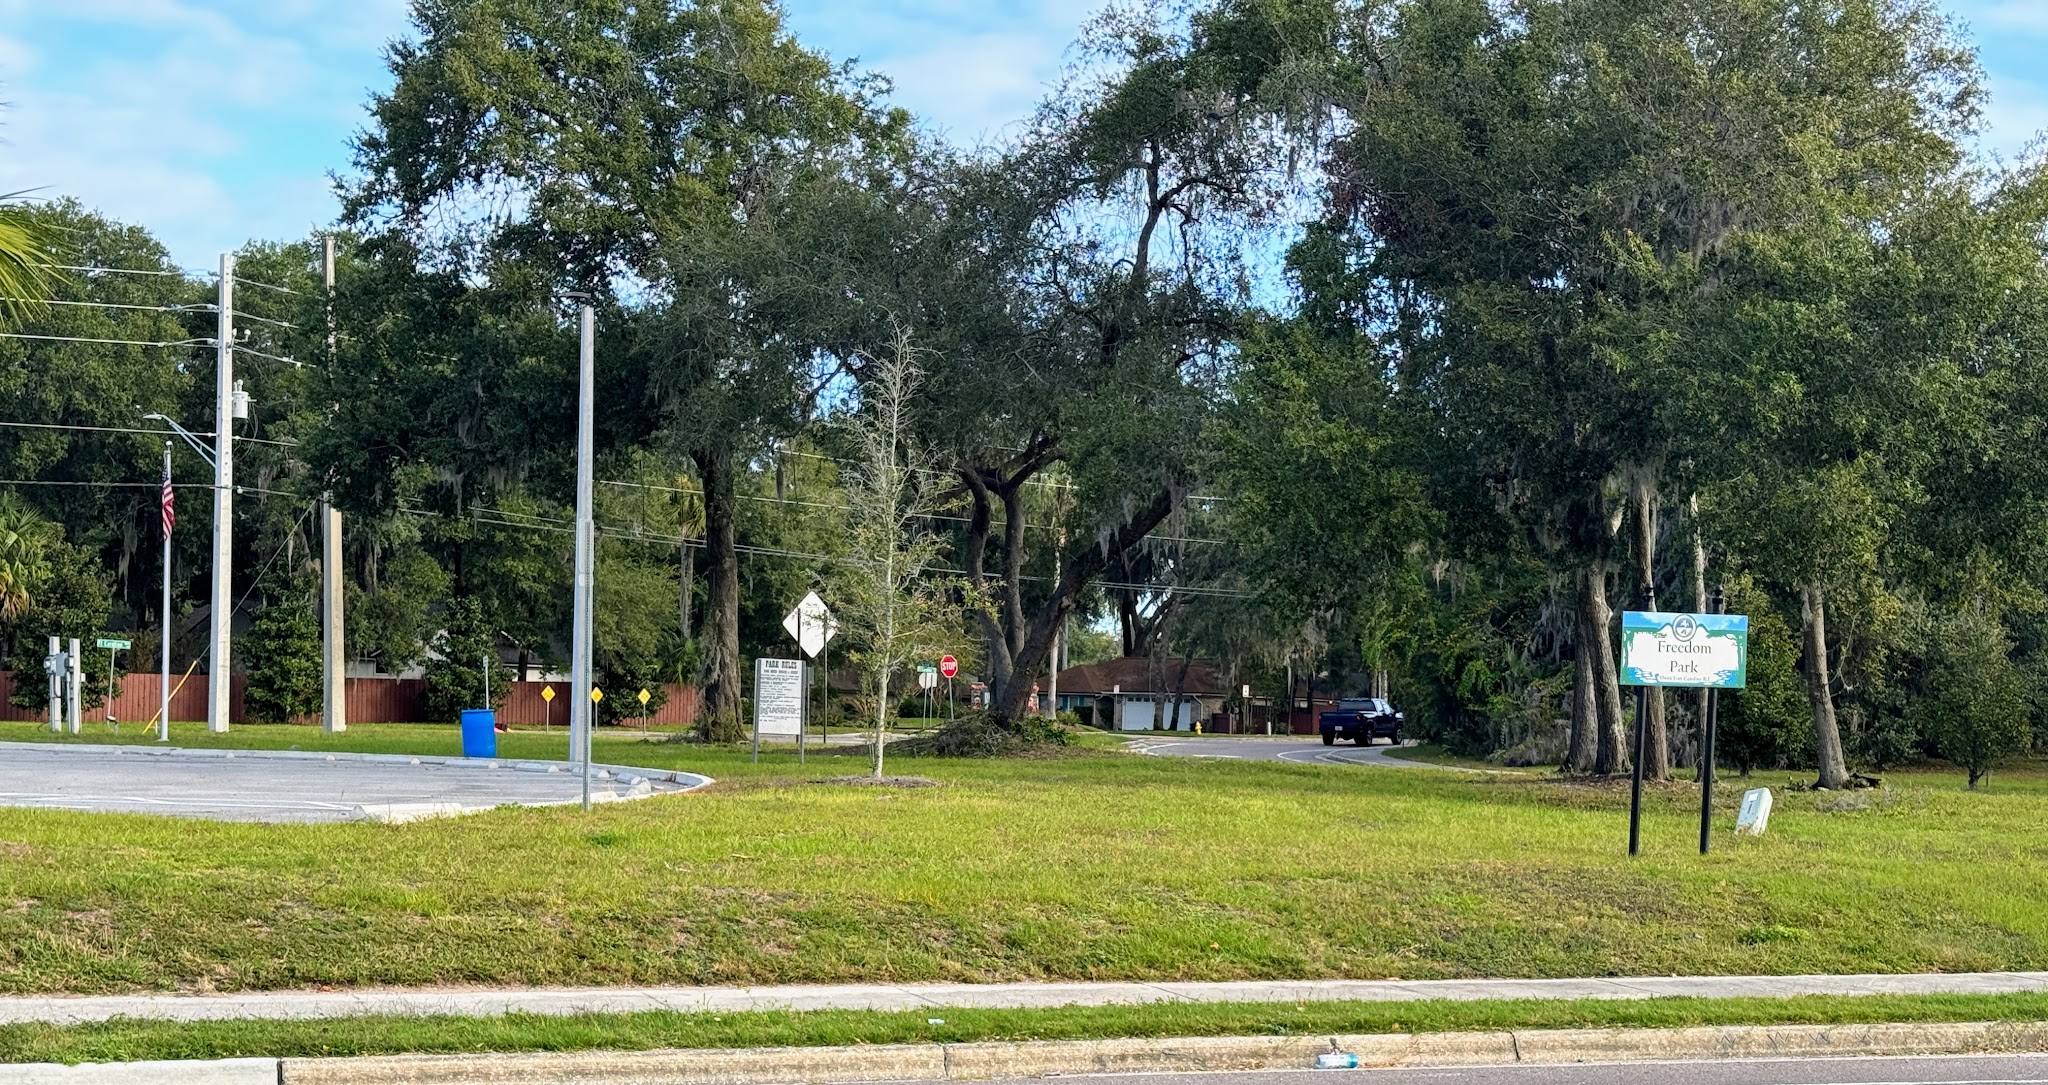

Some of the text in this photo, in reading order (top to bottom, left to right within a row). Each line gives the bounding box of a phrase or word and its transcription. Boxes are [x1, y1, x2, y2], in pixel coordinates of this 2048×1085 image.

[1658, 641, 1712, 654] Freedom
[765, 660, 797, 669] PARK RULES
[942, 661, 957, 671] STOP
[1670, 660, 1698, 673] Park
